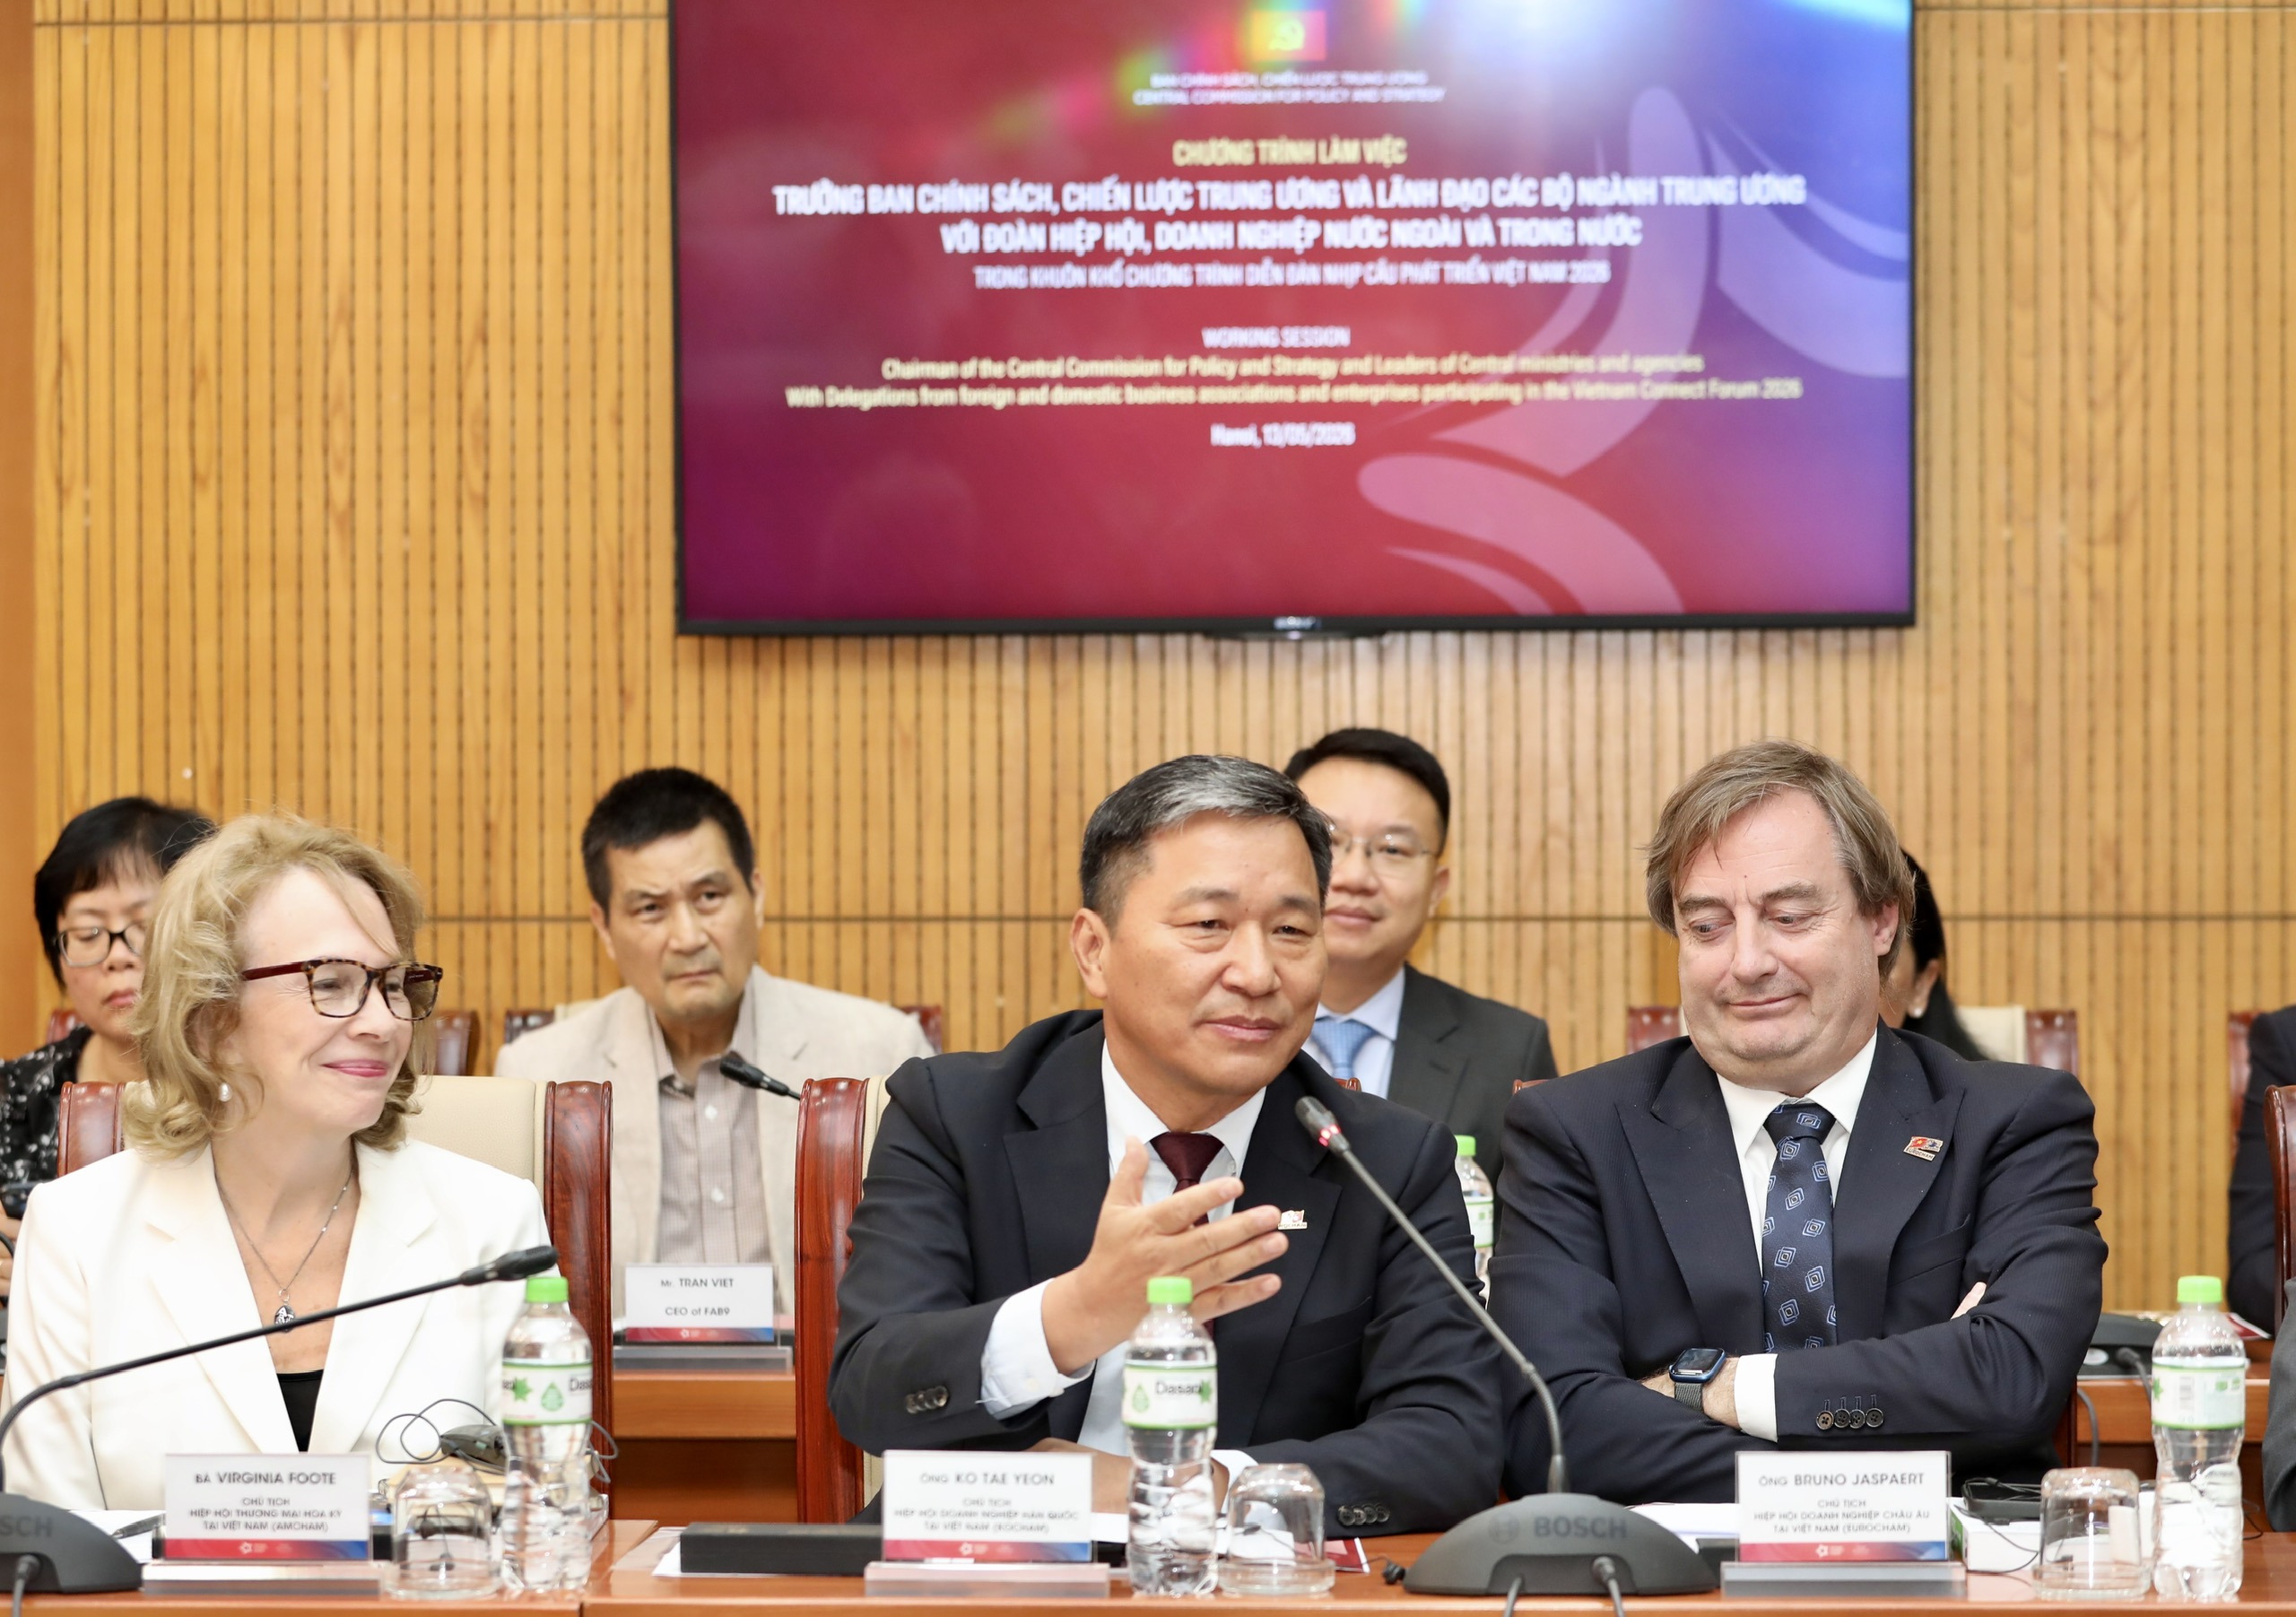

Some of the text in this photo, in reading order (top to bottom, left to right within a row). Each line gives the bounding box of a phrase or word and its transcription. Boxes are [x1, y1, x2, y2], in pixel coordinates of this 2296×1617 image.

[1201, 326, 1351, 348] WORKING SESSION
[679, 1278, 708, 1287] TRAN
[711, 1278, 734, 1287] VIET
[665, 1307, 730, 1316] CEO of FAB9
[217, 1472, 284, 1484] VIRGINIA
[289, 1472, 336, 1484] FOOTE
[955, 1473, 978, 1484] KO
[983, 1473, 1006, 1484] TAE
[1013, 1473, 1055, 1484] YEON
[1794, 1474, 1847, 1485] BRUNO
[1852, 1473, 1924, 1485] JASPAERT
[304, 1509, 326, 1517] HOA
[0, 1515, 52, 1537] SCH
[272, 1521, 328, 1532] (AMCHAM)
[1534, 1516, 1627, 1539] BOSCH
